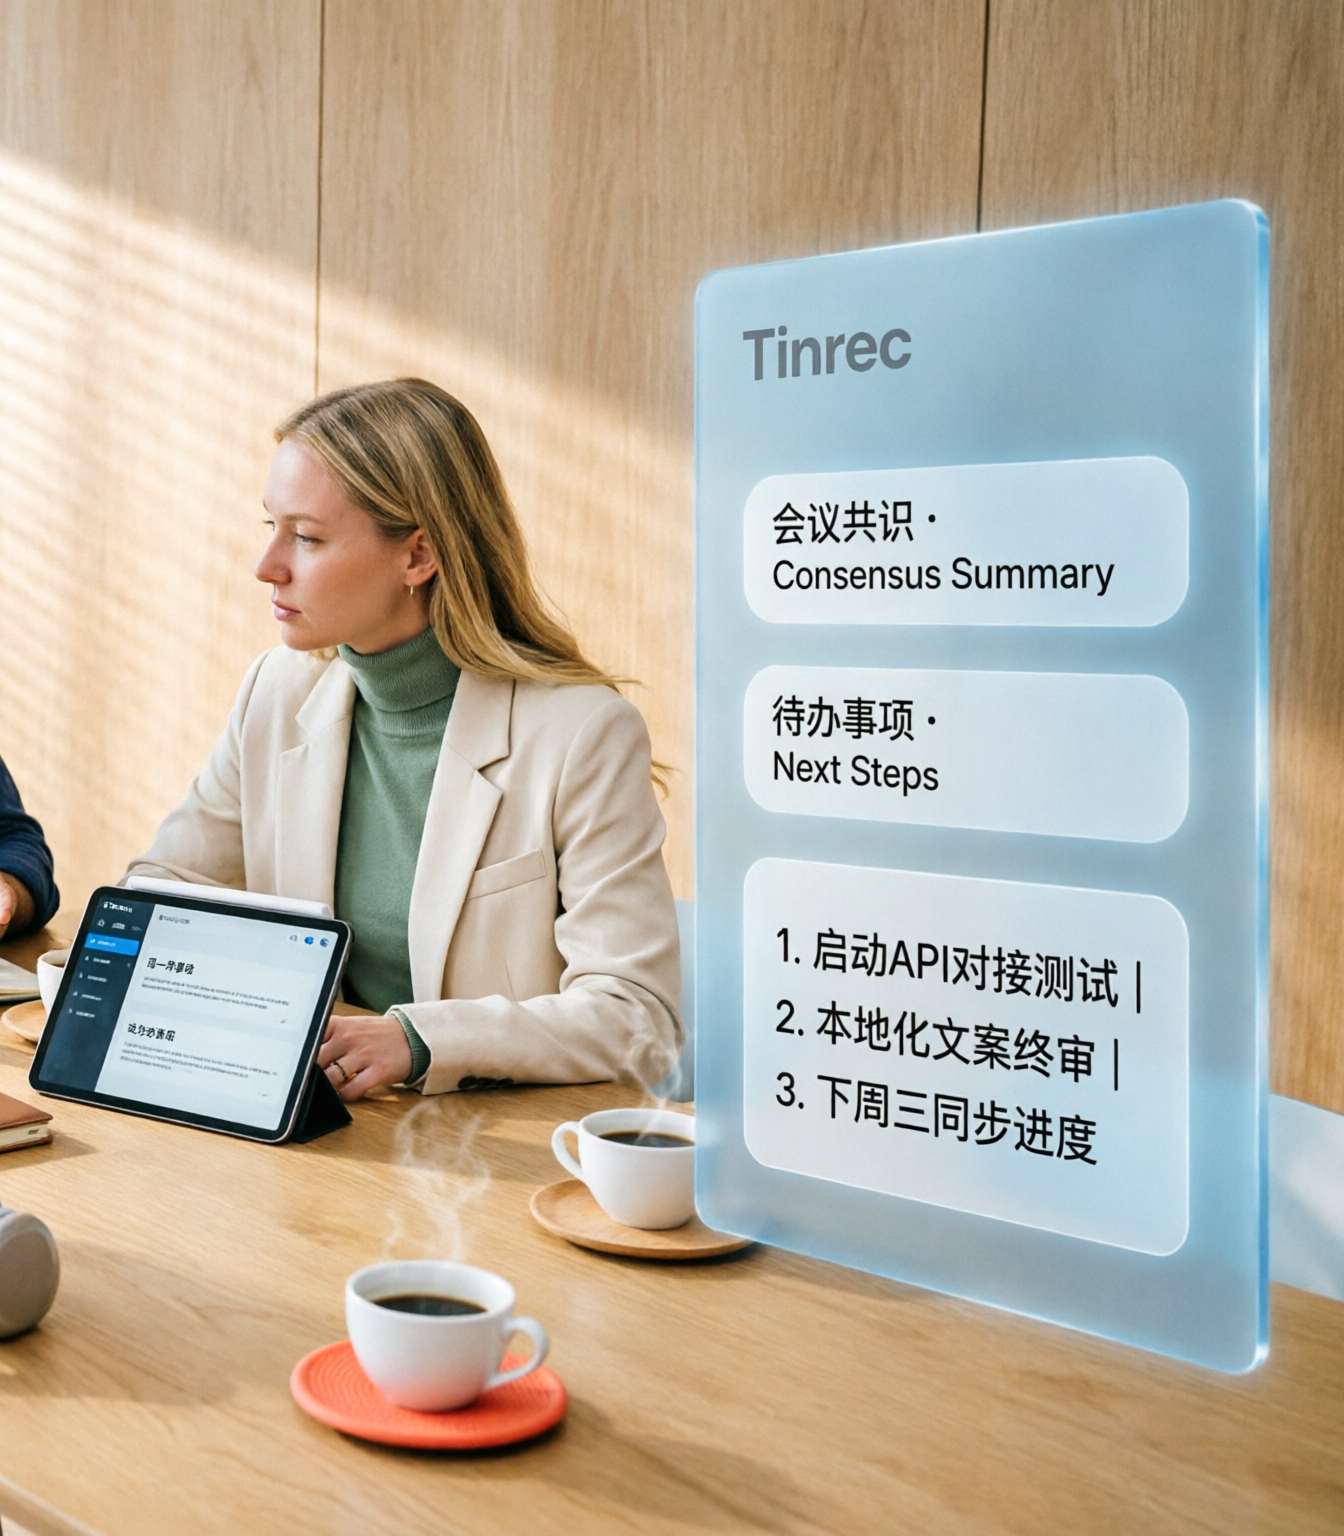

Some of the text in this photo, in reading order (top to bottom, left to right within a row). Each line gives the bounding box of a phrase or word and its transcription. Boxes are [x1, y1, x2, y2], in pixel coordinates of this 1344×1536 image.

[743, 325, 912, 381] Tinrec
[772, 500, 914, 545] 会议共识
[773, 556, 1115, 597] Consensus Summary
[772, 694, 915, 741] 待办事项
[773, 750, 939, 797] Next Steps
[776, 927, 801, 965] 1.
[812, 927, 1119, 1008] 启动API对接测试
[775, 999, 804, 1037] 2.
[816, 1000, 1095, 1083] 本地化文案终审
[775, 1071, 1098, 1166] 3. 下周三同步进度
